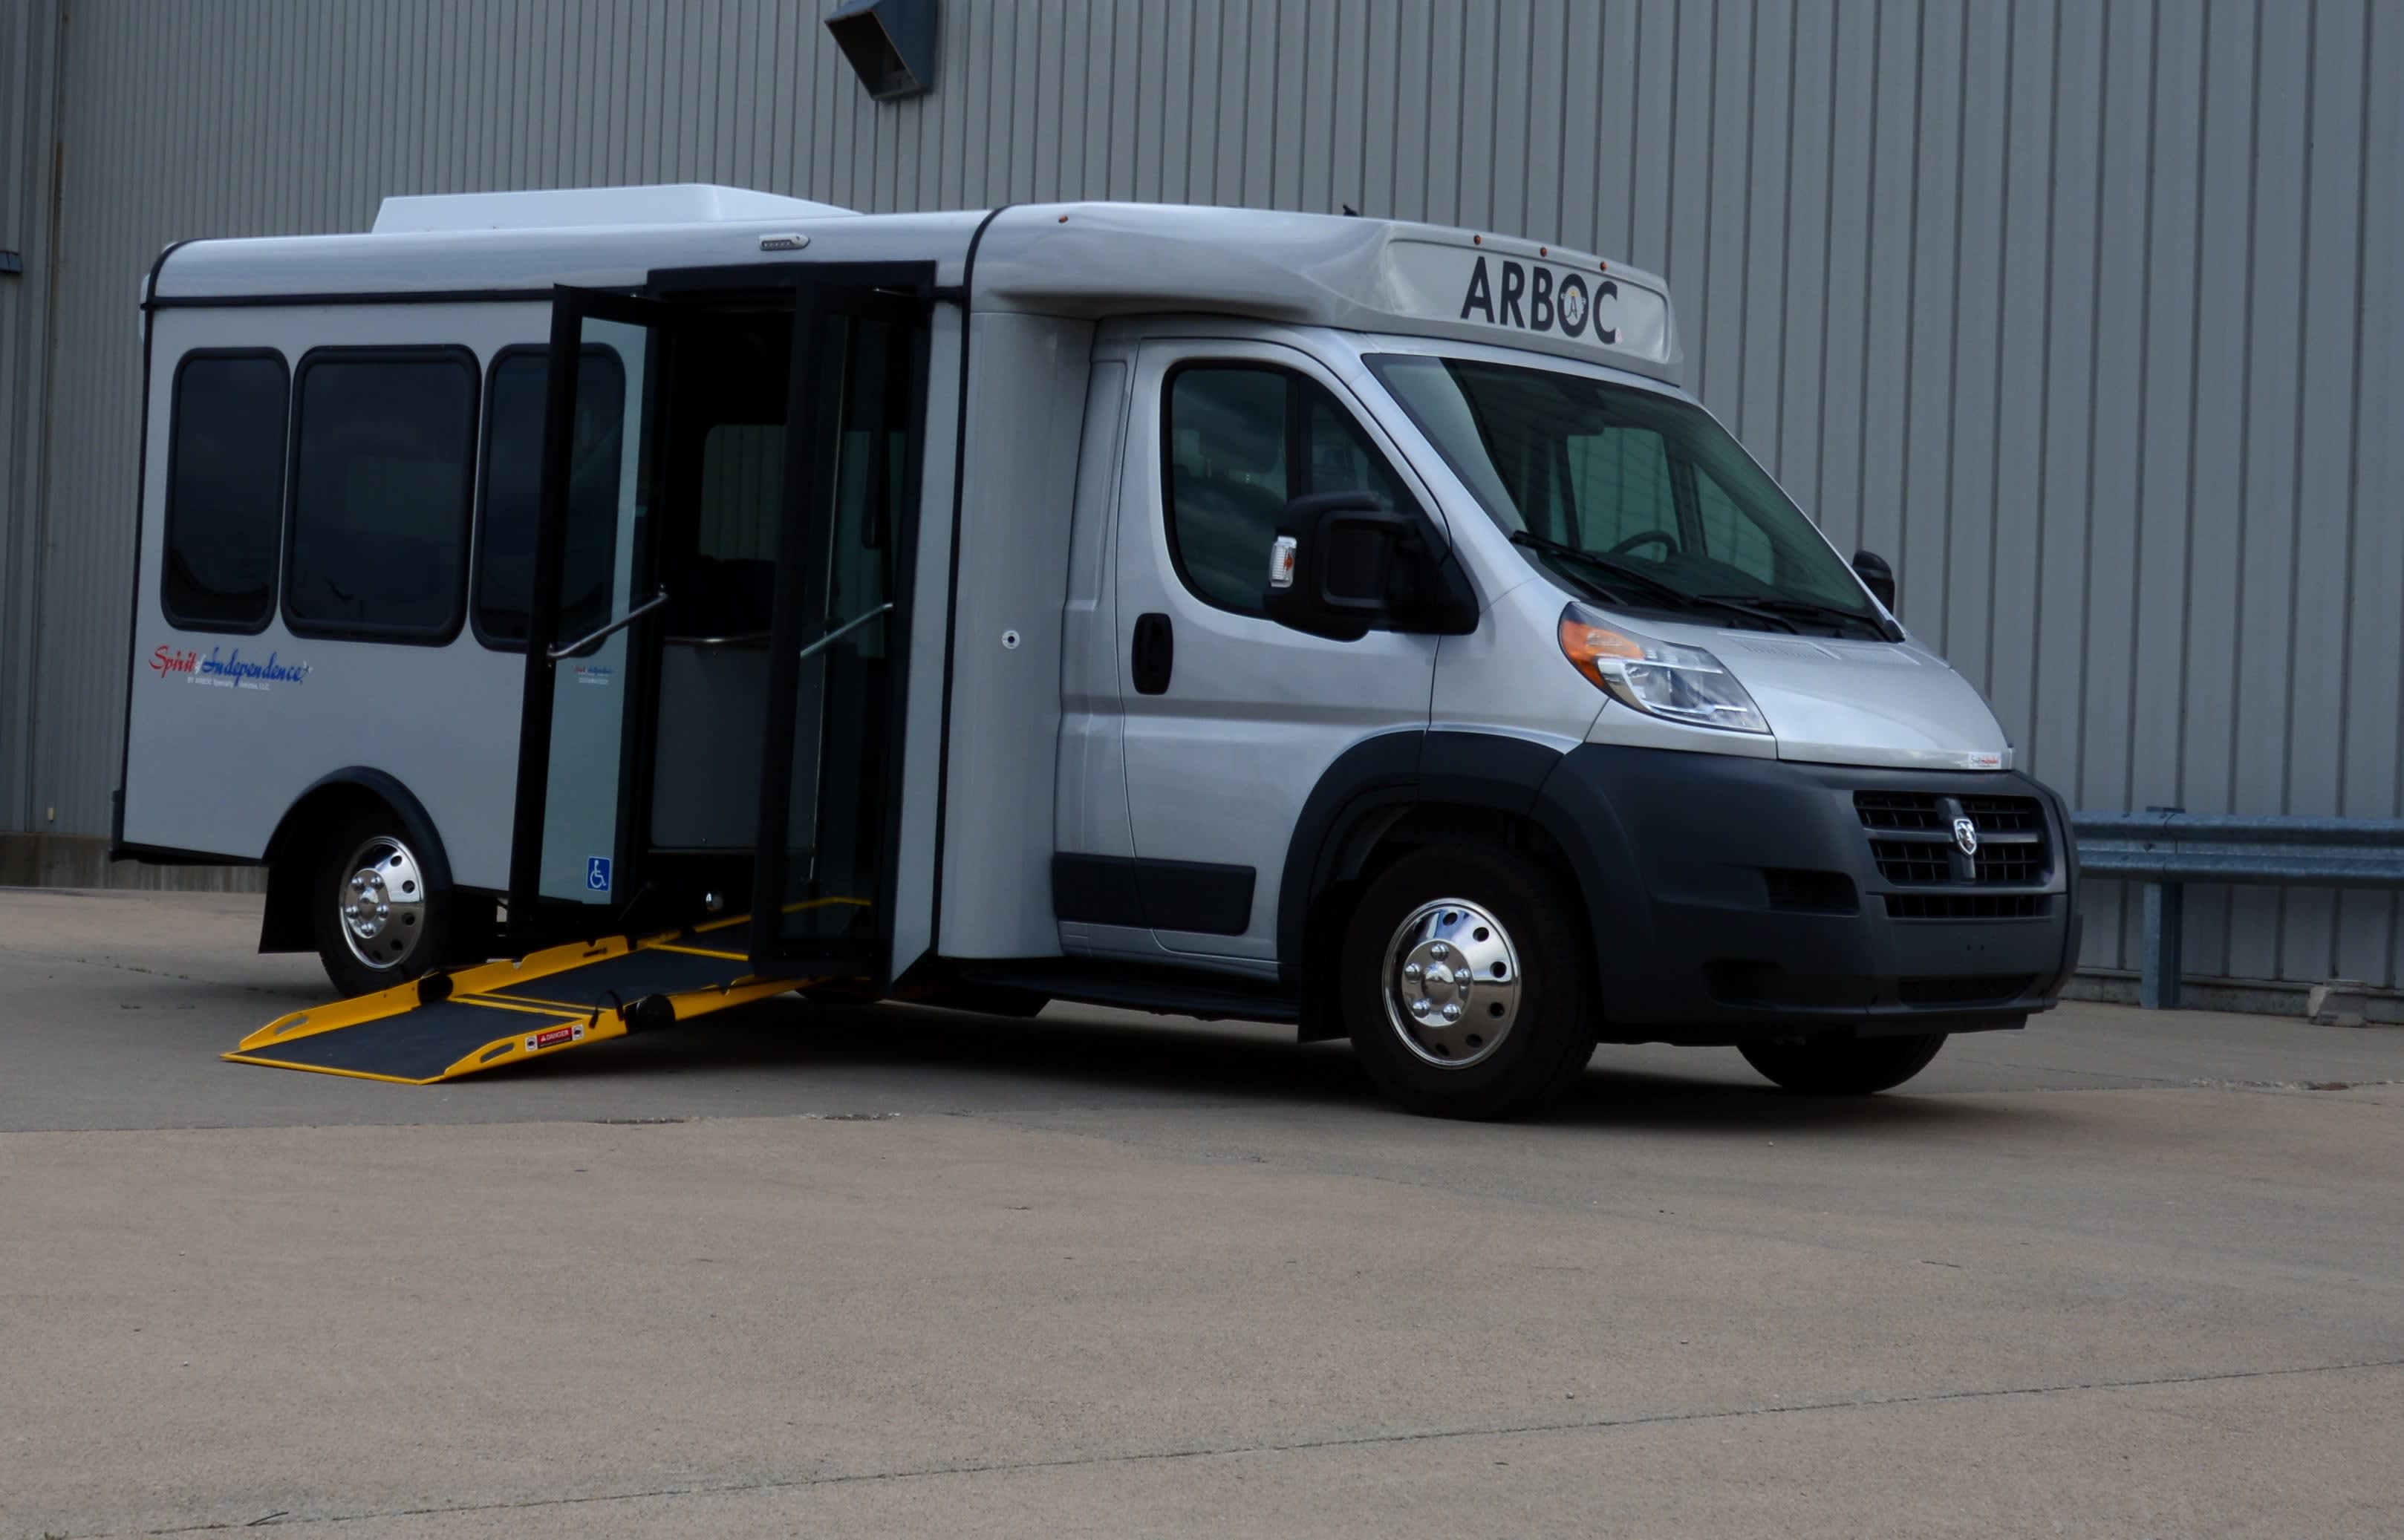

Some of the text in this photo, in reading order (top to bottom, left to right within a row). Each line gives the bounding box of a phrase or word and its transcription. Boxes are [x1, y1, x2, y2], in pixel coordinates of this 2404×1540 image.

[1460, 256, 1618, 345] ARBOC
[149, 645, 197, 678] Spirit
[201, 645, 302, 687] Independence
[546, 1029, 569, 1041] DANGER
